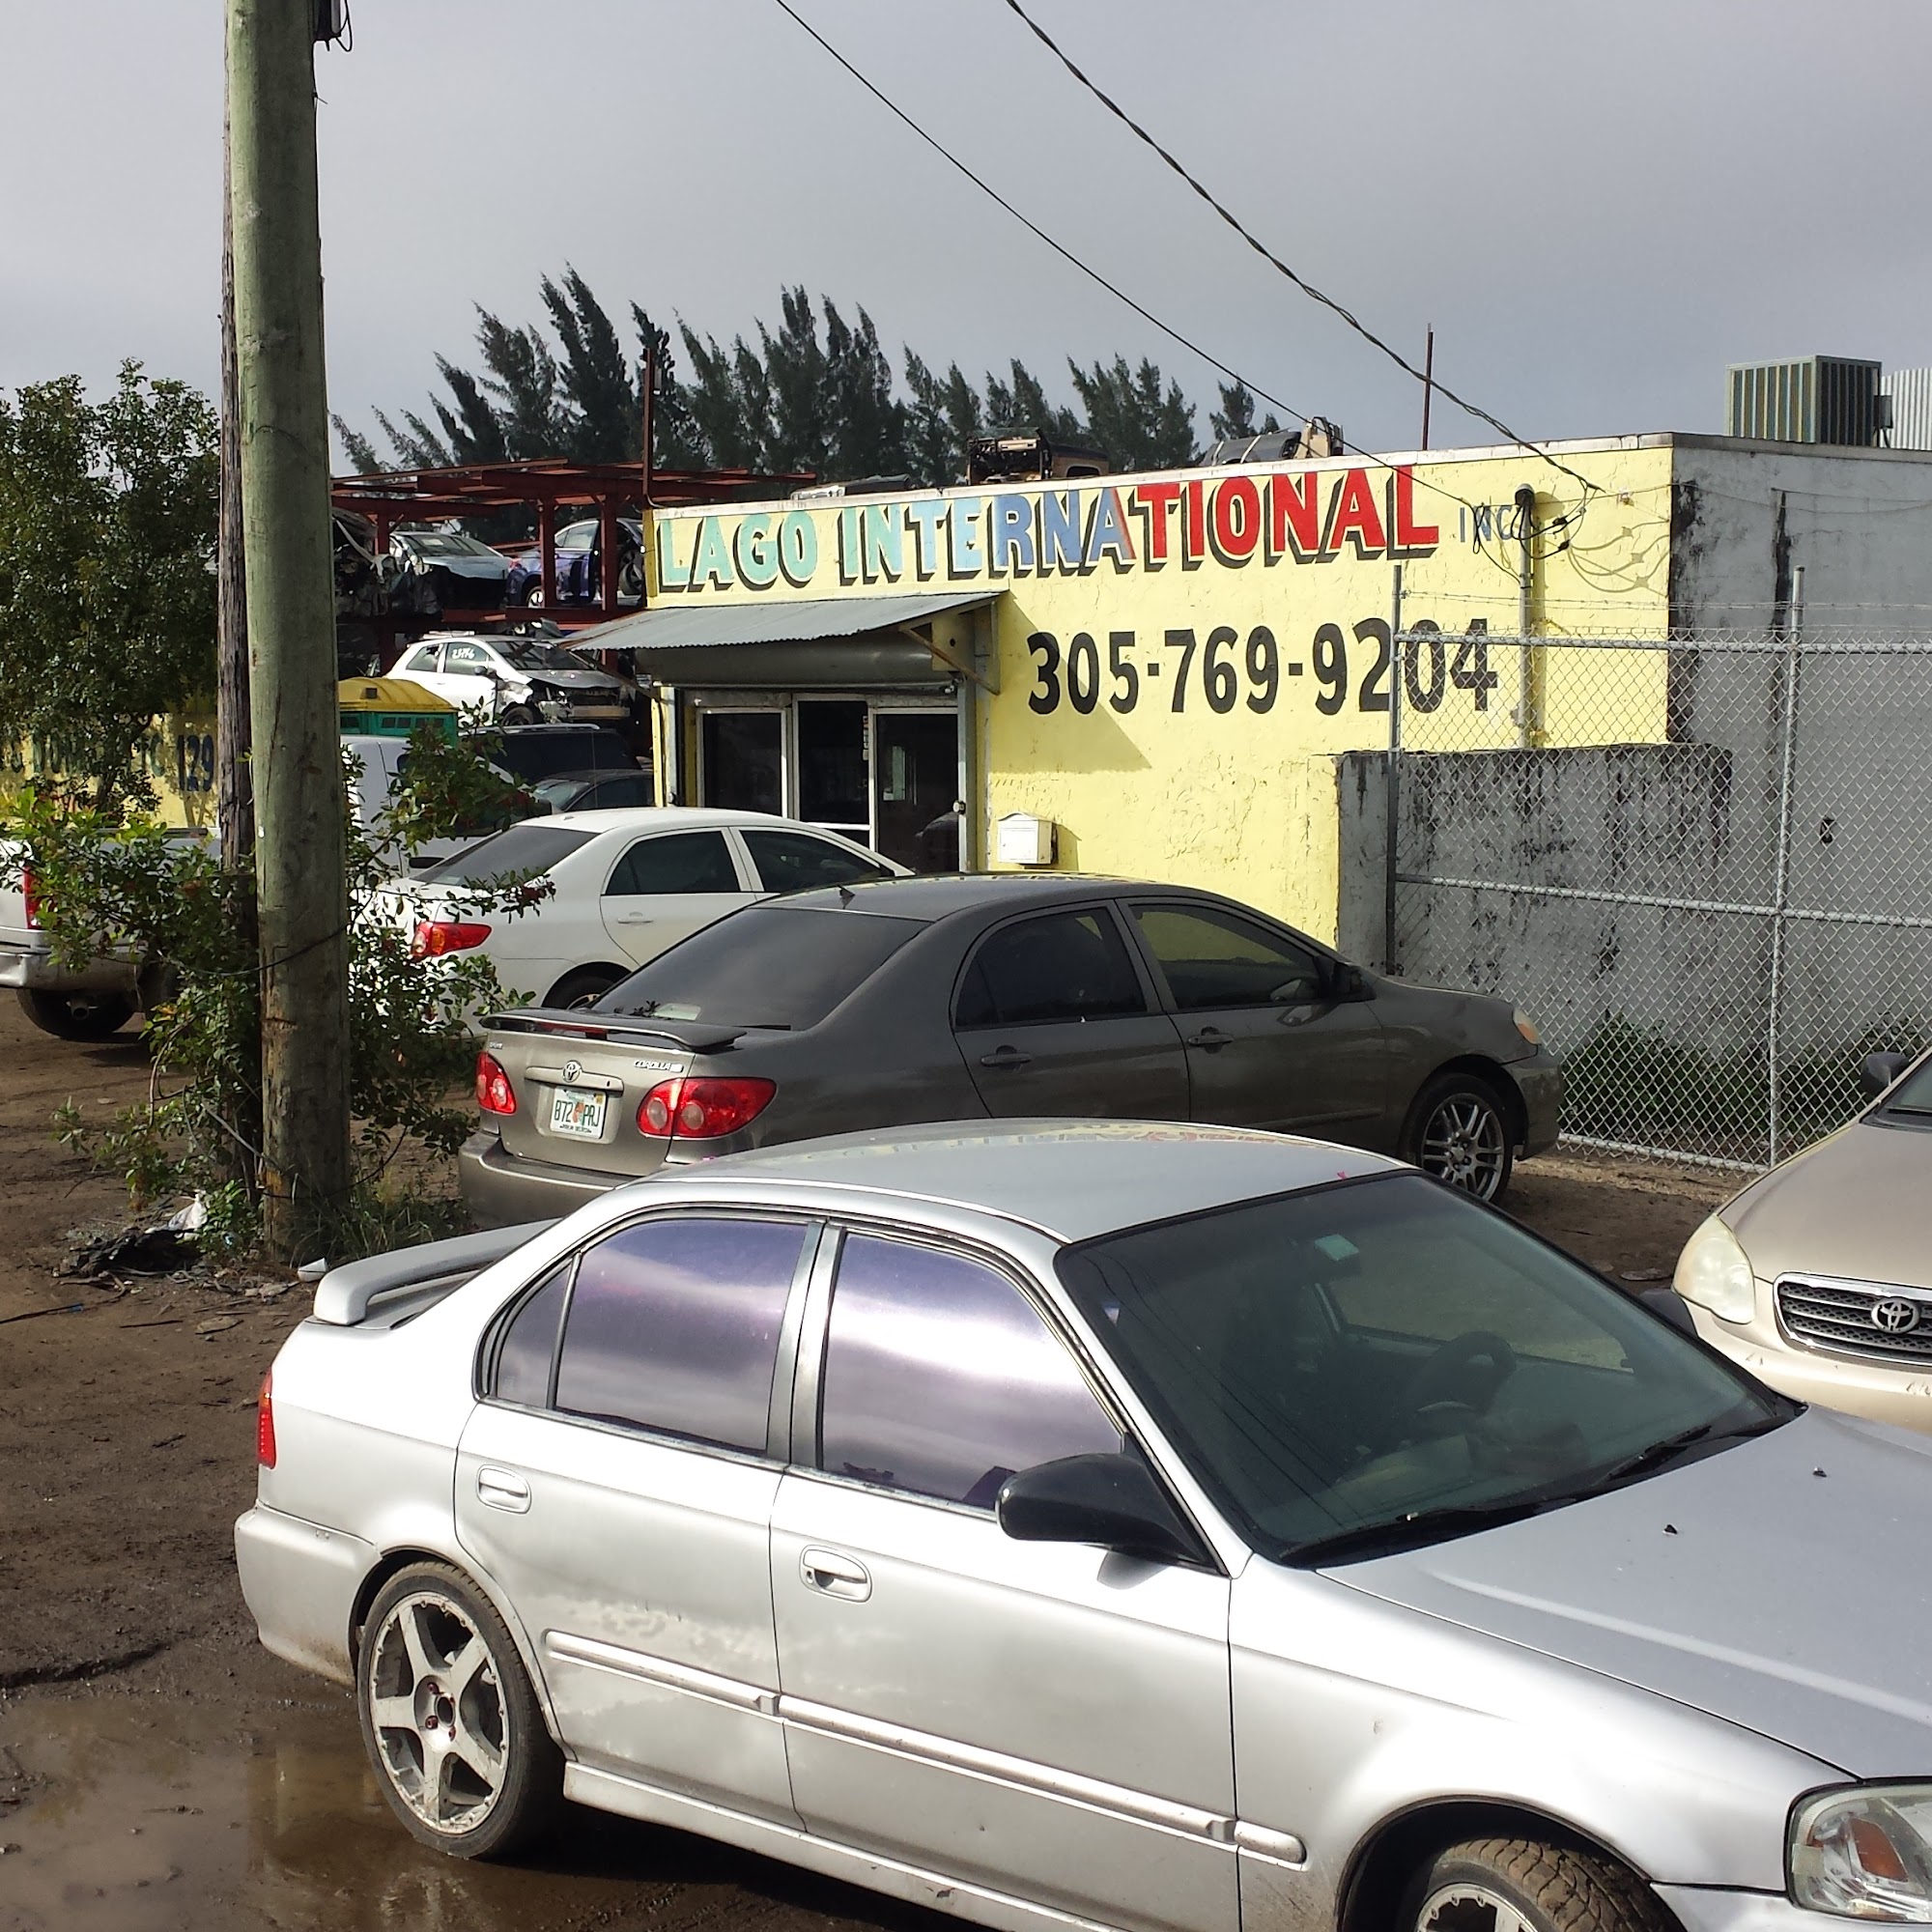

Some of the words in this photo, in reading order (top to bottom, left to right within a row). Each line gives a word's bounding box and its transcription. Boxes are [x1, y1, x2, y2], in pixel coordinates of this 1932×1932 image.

[658, 509, 818, 593] LAGO
[838, 465, 1439, 586] INTERNATIONAL
[1027, 616, 1498, 715] 305-769-9204
